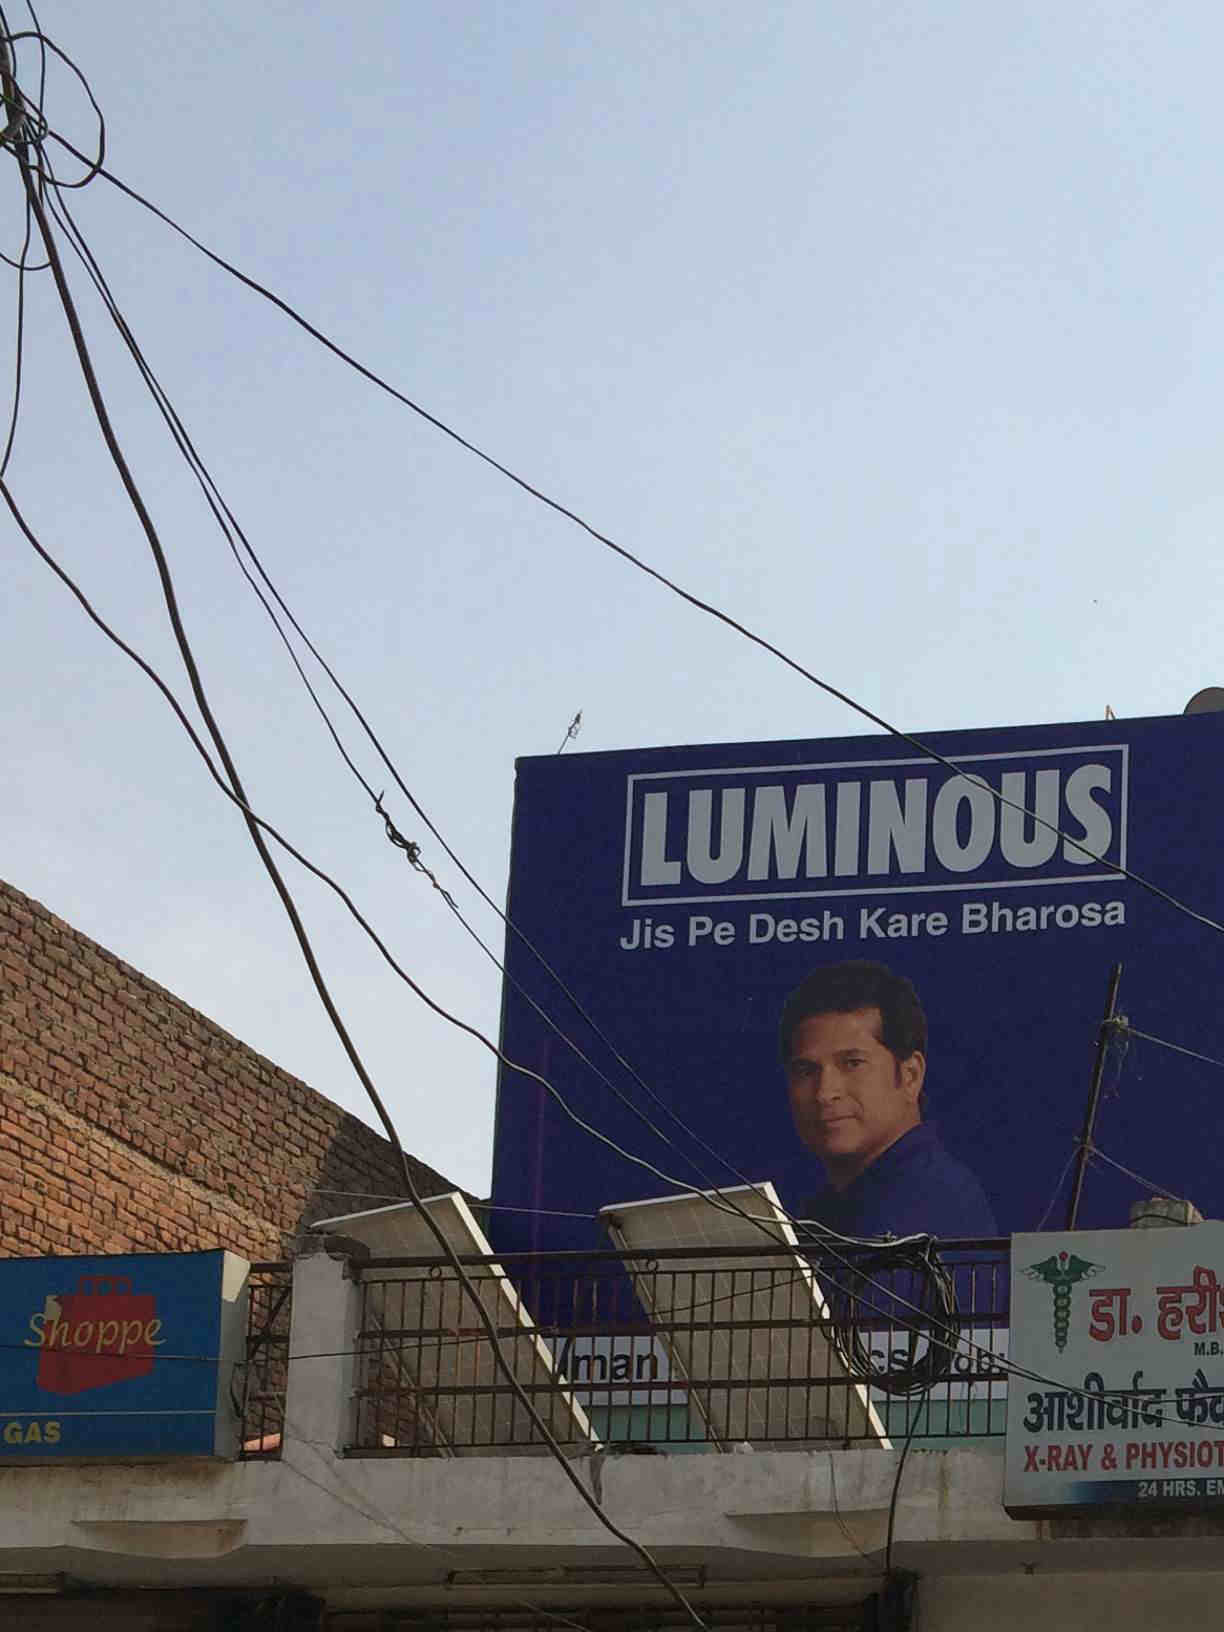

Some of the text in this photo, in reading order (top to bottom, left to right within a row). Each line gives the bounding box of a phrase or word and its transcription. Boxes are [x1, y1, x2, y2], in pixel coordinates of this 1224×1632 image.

[640, 763, 1114, 887] LUMINOUS
[620, 898, 1126, 950] Jis Pe Desh Kare Bharosa
[24, 1312, 167, 1354] Shoppe
[3, 1421, 62, 1444] GAS
[1023, 1443, 1093, 1472] X-RAY
[1100, 1444, 1117, 1471] &
[1137, 1481, 1159, 1498] 24
[1163, 1480, 1201, 1497] HRS.
